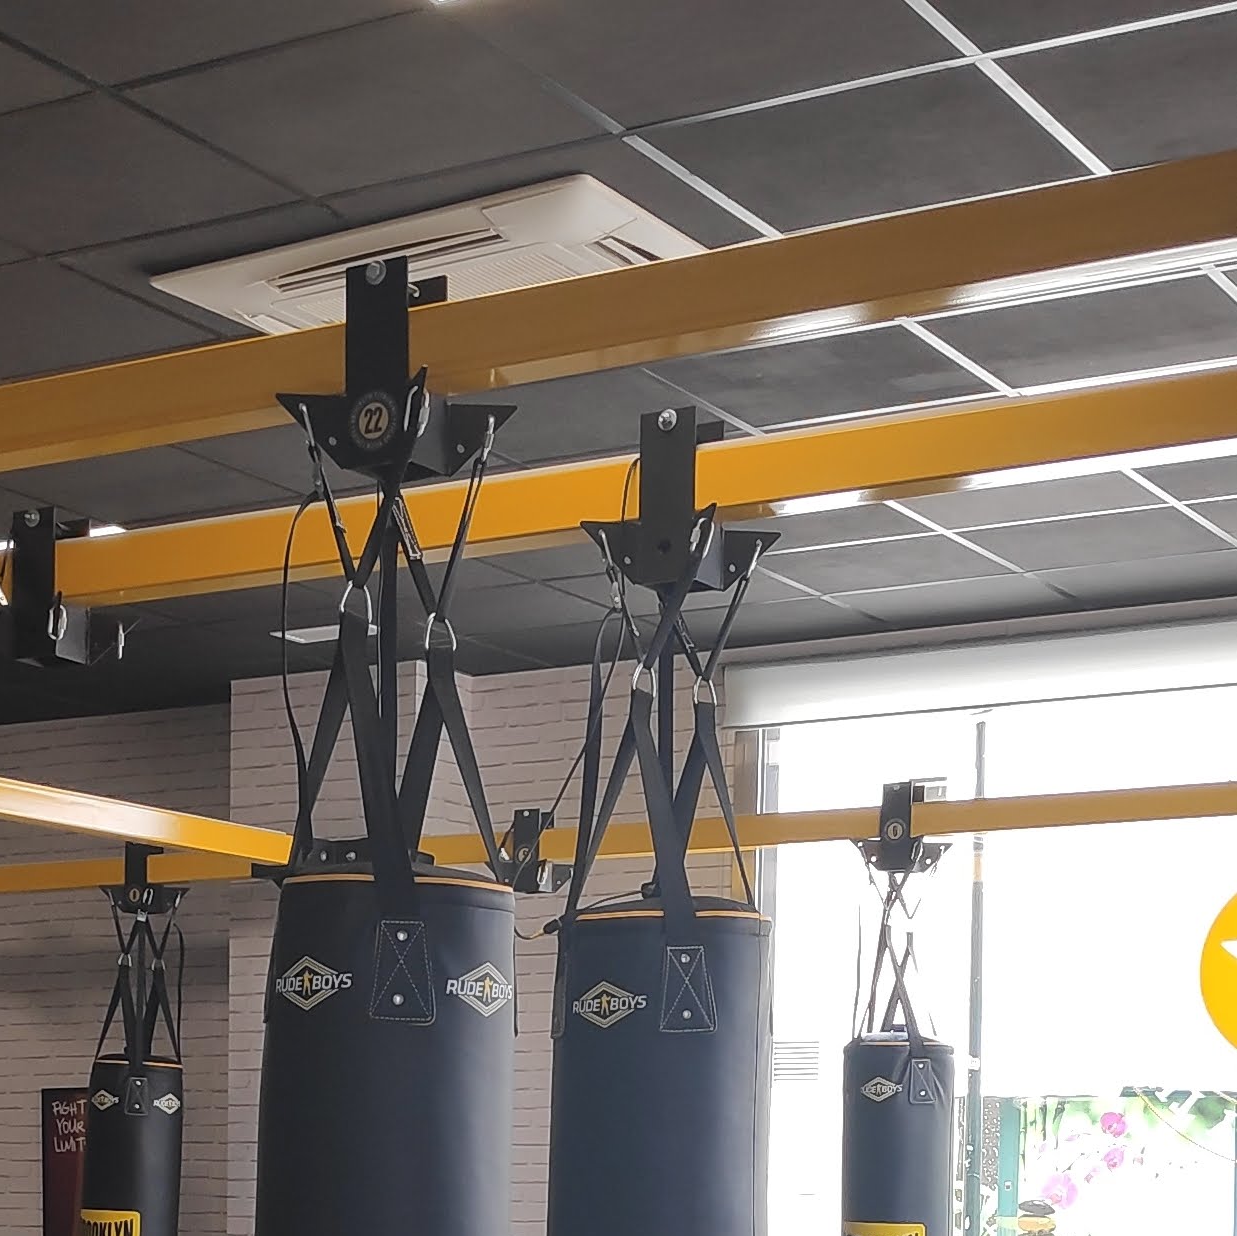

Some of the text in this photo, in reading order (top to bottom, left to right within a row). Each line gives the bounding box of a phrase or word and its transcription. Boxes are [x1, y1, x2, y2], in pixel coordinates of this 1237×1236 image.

[365, 407, 383, 434] 22
[275, 973, 353, 993] RUDE BOYS
[446, 979, 513, 1000] RUDE BOYS
[572, 995, 648, 1014] RUDE BOYS
[52, 1099, 88, 1117] FIGHT
[56, 1118, 86, 1135] YOUR
[54, 1136, 86, 1153] LIMIT
